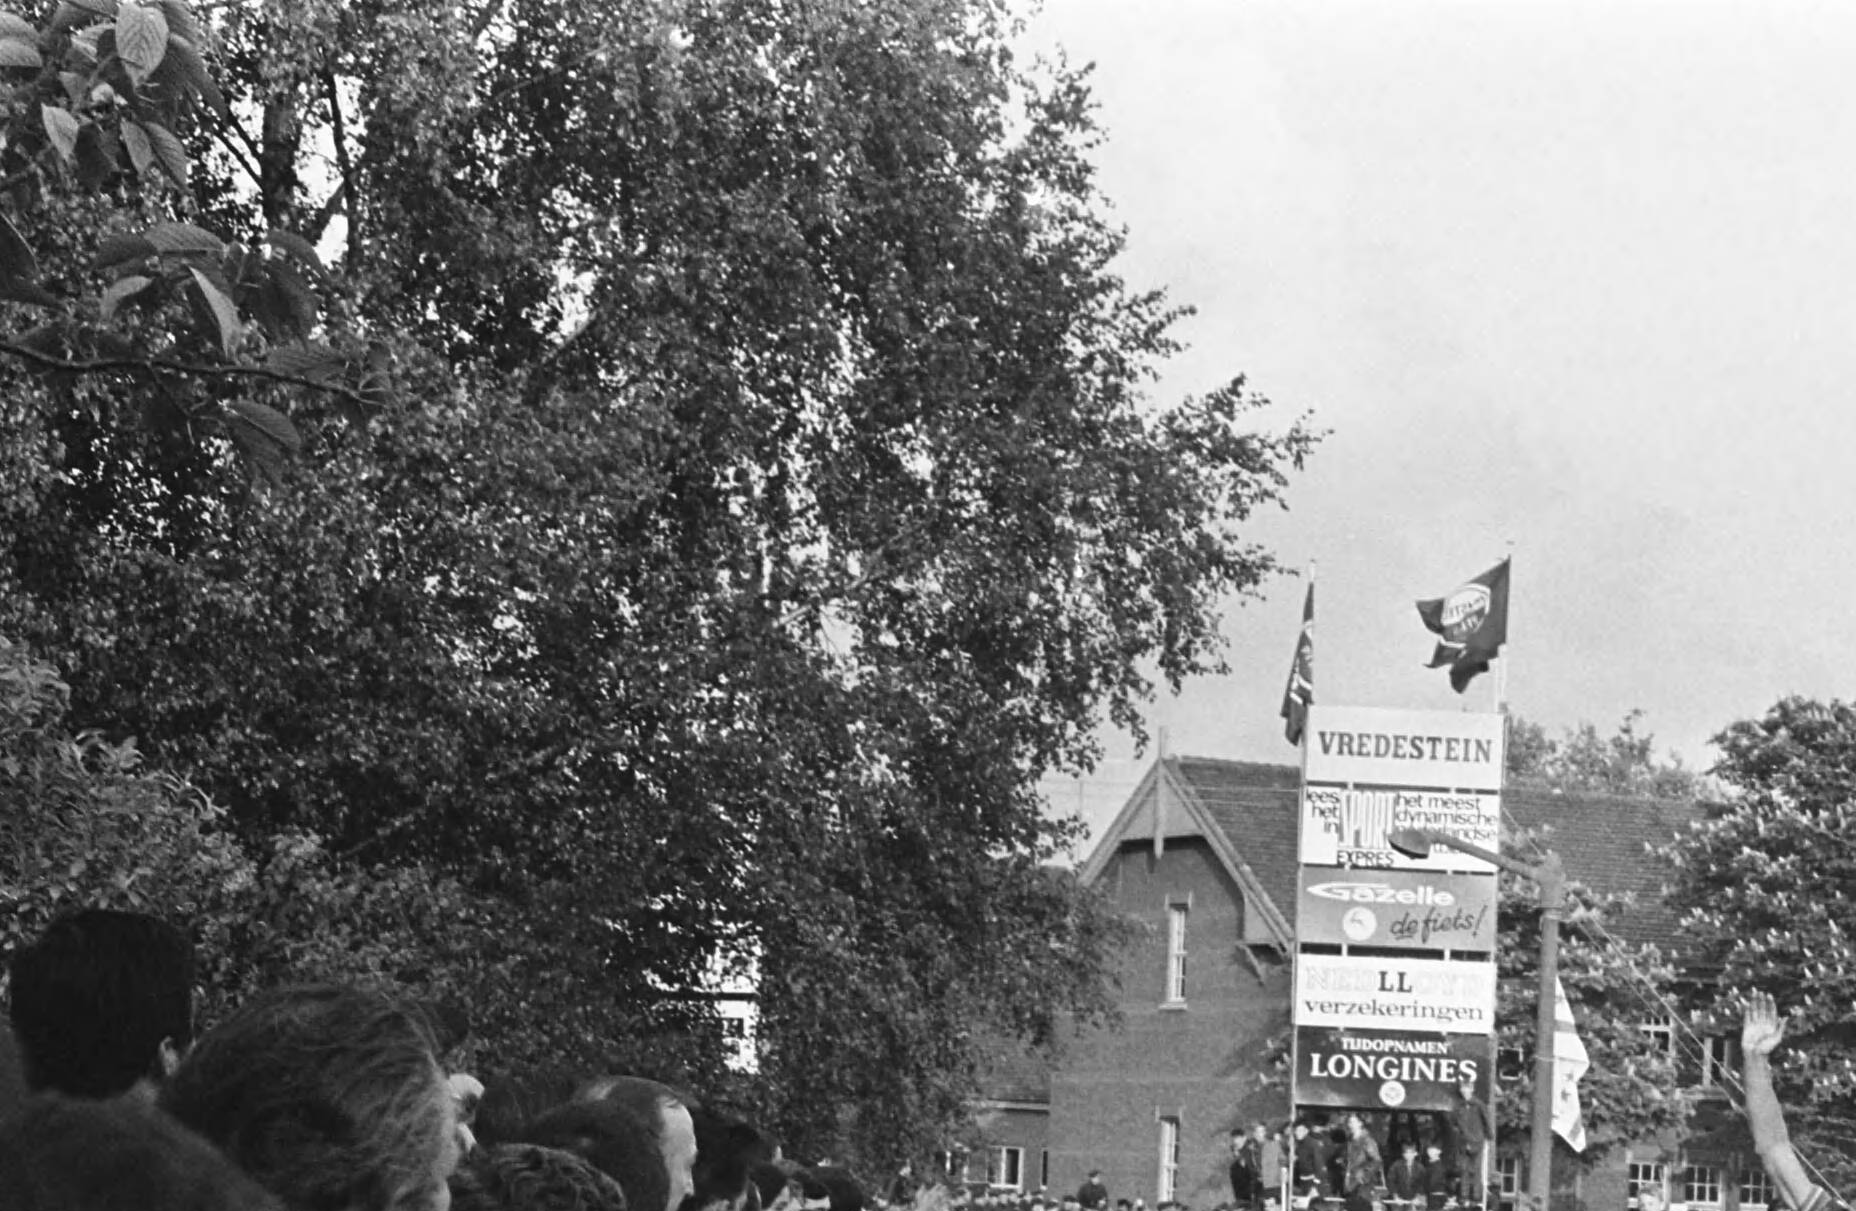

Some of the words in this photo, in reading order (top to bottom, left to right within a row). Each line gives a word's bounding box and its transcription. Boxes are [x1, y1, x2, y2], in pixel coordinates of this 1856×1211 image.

[1317, 730, 1493, 763] VREDESTEIN
[1306, 789, 1340, 804] lees
[1396, 793, 1422, 809] het
[1427, 797, 1481, 811] meest
[1312, 803, 1339, 819] het
[1337, 850, 1395, 867] EXPRES
[1306, 882, 1455, 906] Gazelle
[1390, 912, 1419, 938] de
[1305, 998, 1484, 1022] verzekeringen
[1310, 1053, 1478, 1083] LONGINES
